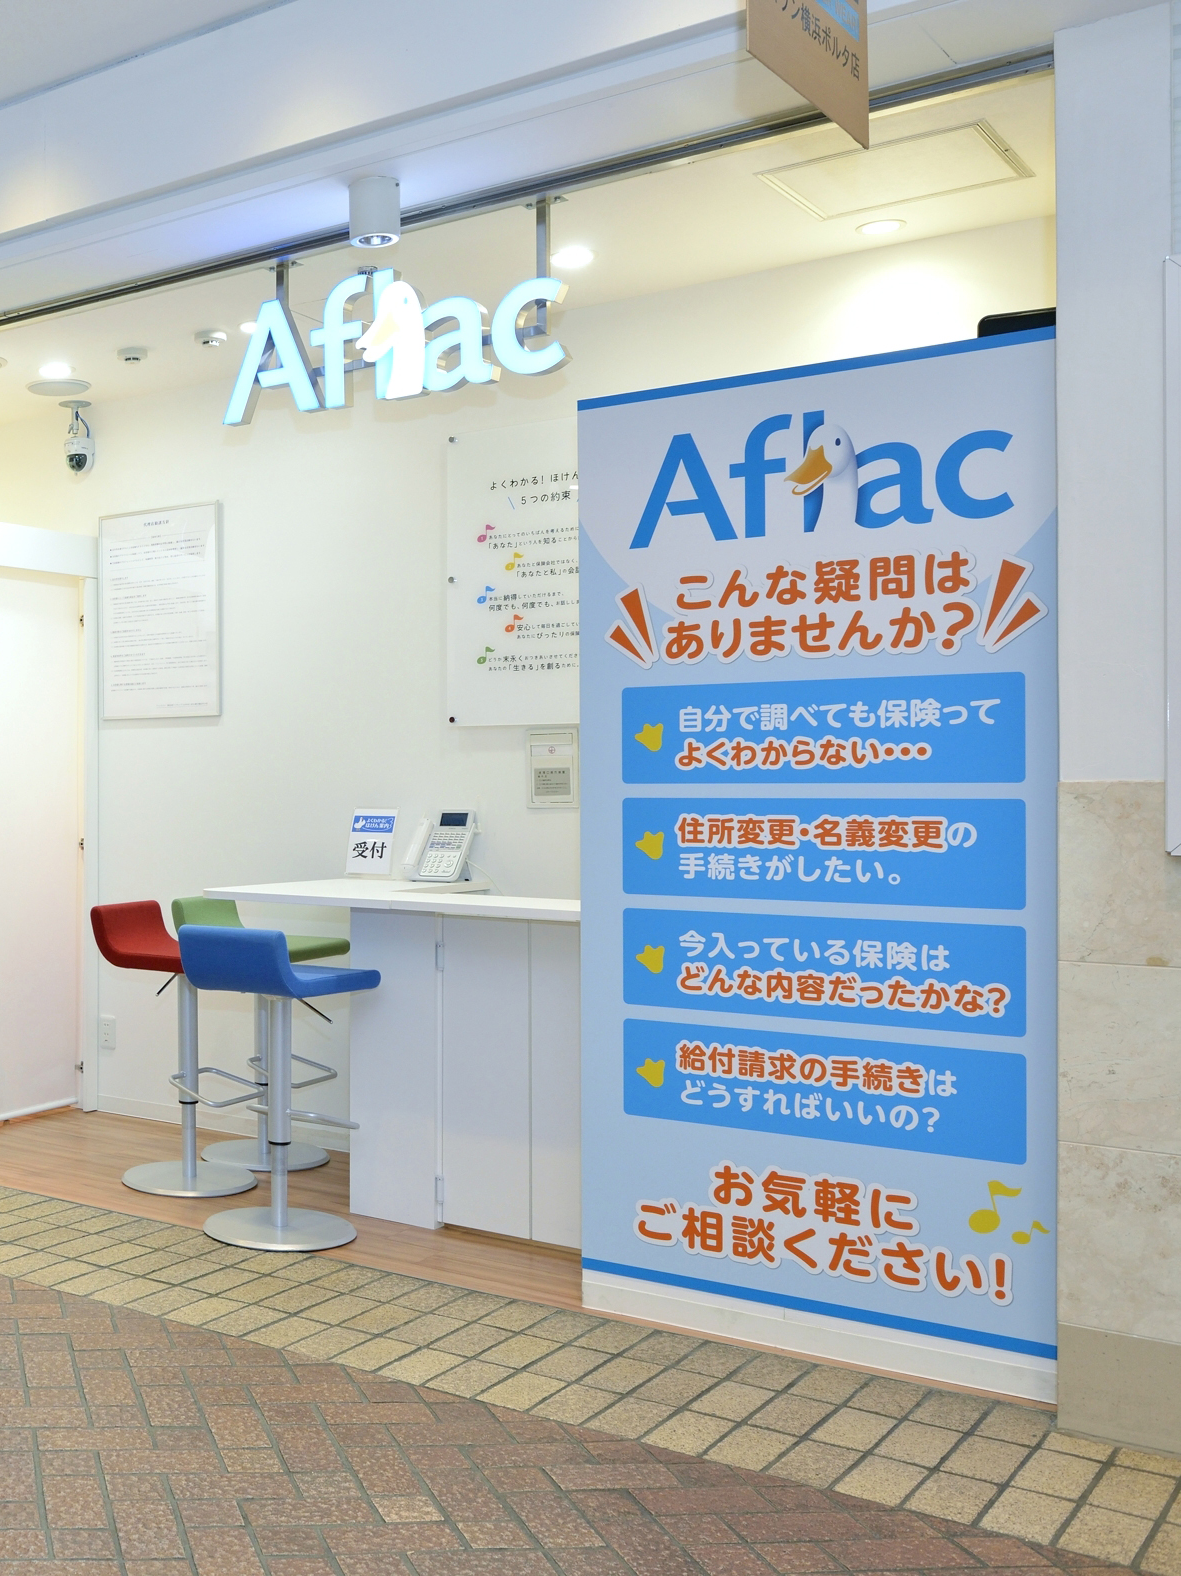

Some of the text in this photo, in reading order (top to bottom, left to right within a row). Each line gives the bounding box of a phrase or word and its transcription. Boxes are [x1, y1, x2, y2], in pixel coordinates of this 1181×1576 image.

[521, 490, 571, 505] 5つの約束
[628, 409, 1015, 550] Aflac
[676, 551, 970, 611] こんな疑問は
[665, 601, 975, 660] ありませんか?
[678, 697, 1002, 732] 自分で調べても保険って
[352, 841, 387, 859] 受付
[677, 817, 978, 849] 住所変更・名義変更の
[678, 854, 902, 886] 手続きがしたい。
[678, 930, 950, 972] 今入っている保険は
[679, 965, 1007, 1014] どんな内容だったかな?
[679, 1043, 957, 1097] 給付請求の手続きは
[680, 1080, 941, 1133] どうすればいいの?
[713, 1165, 916, 1232] お気軽に
[637, 1202, 1008, 1300] ご相談ください!
